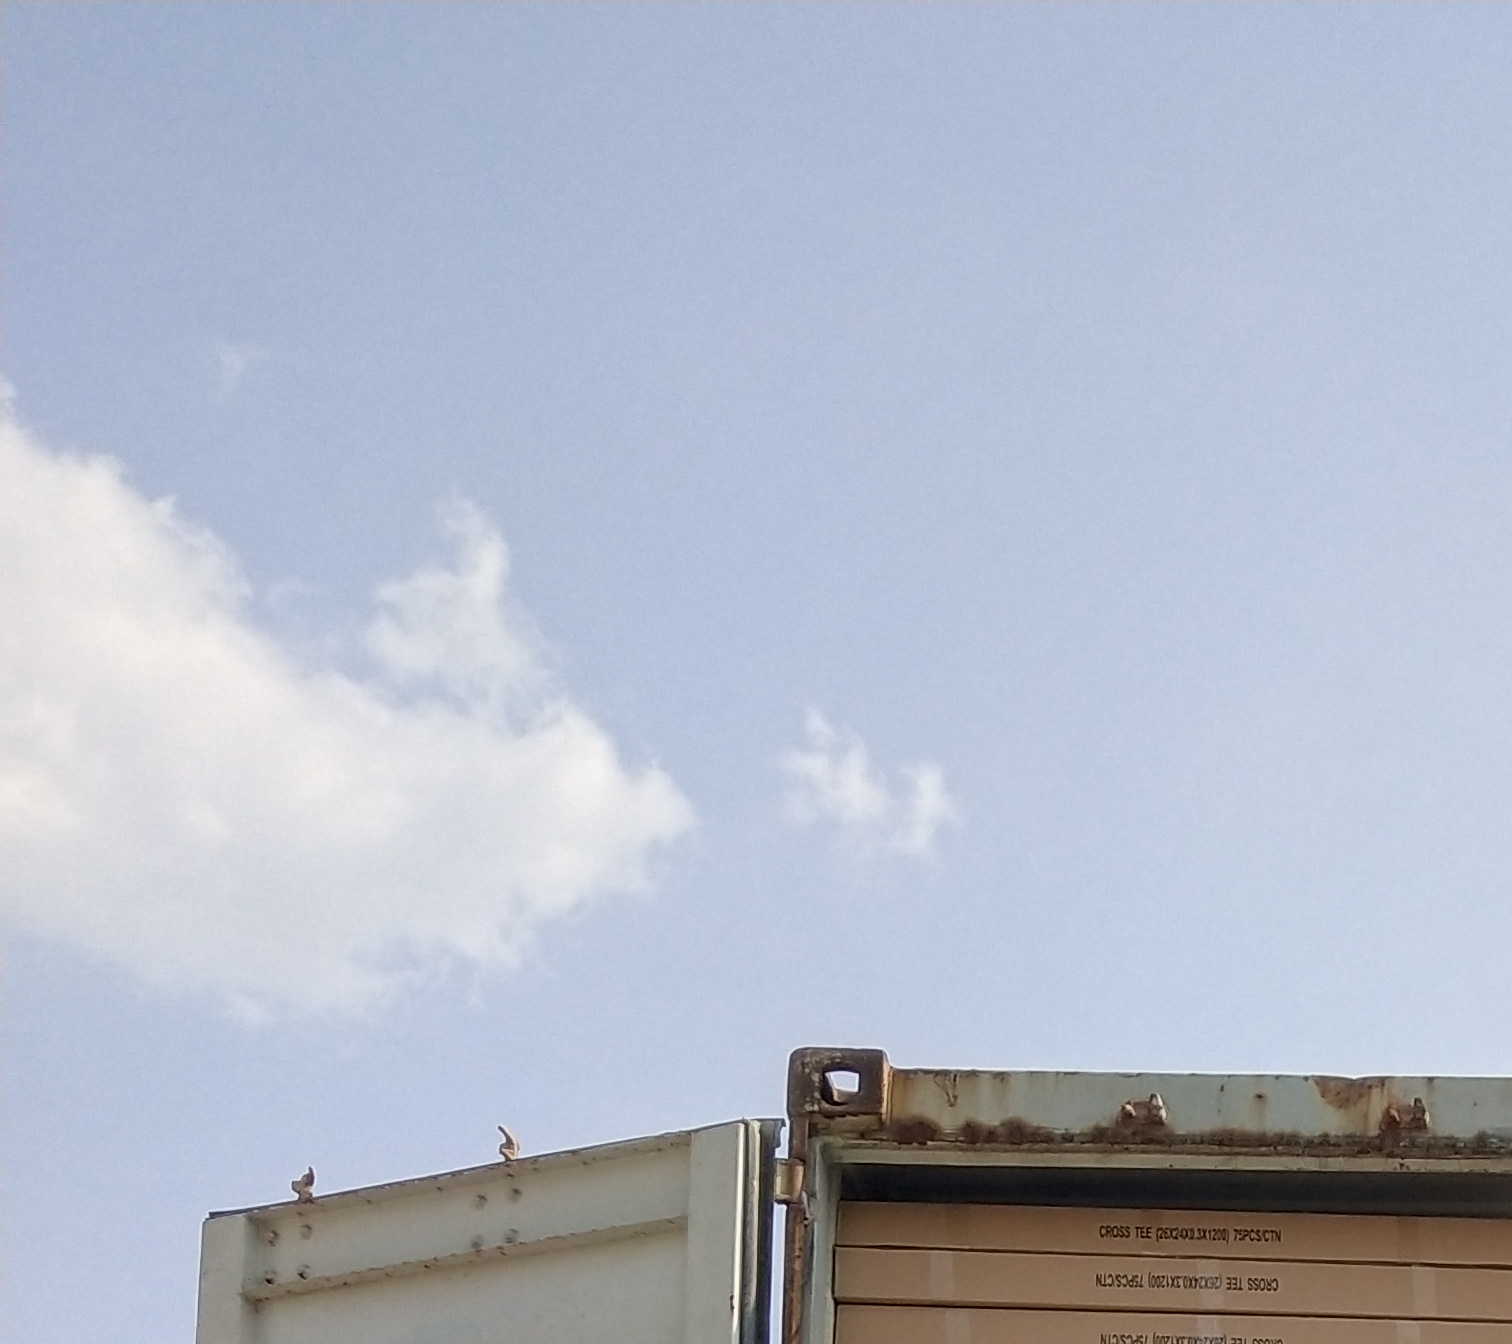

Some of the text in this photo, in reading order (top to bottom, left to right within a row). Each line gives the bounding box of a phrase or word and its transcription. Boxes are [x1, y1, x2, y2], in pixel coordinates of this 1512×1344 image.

[1099, 1225, 1130, 1239] CROSS
[1134, 1226, 1152, 1239] TEE
[1225, 1276, 1243, 1291] TEE
[1247, 1277, 1279, 1292] CROSS
